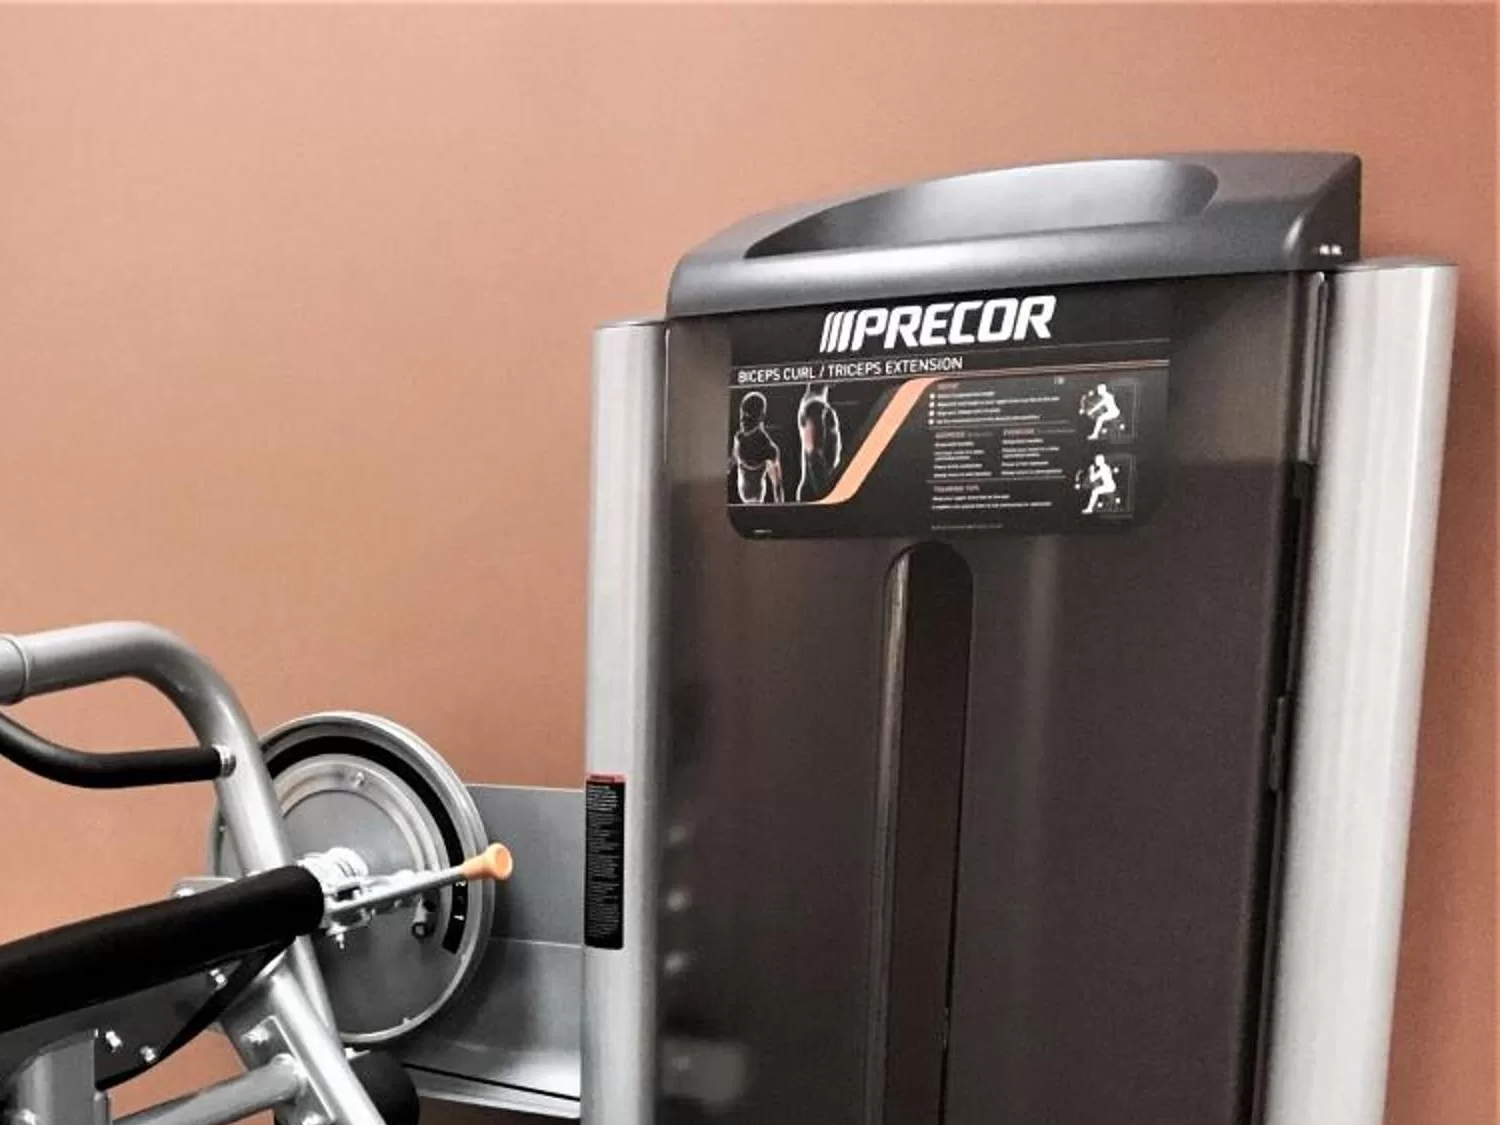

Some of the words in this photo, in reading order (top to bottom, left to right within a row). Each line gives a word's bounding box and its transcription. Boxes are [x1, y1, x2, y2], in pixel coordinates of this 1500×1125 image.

[850, 295, 1057, 351] PRECOR
[738, 370, 780, 383] BICEPS
[783, 366, 815, 381] CURL
[828, 361, 882, 376] TRICEPS
[886, 357, 964, 374] EXTENSION
